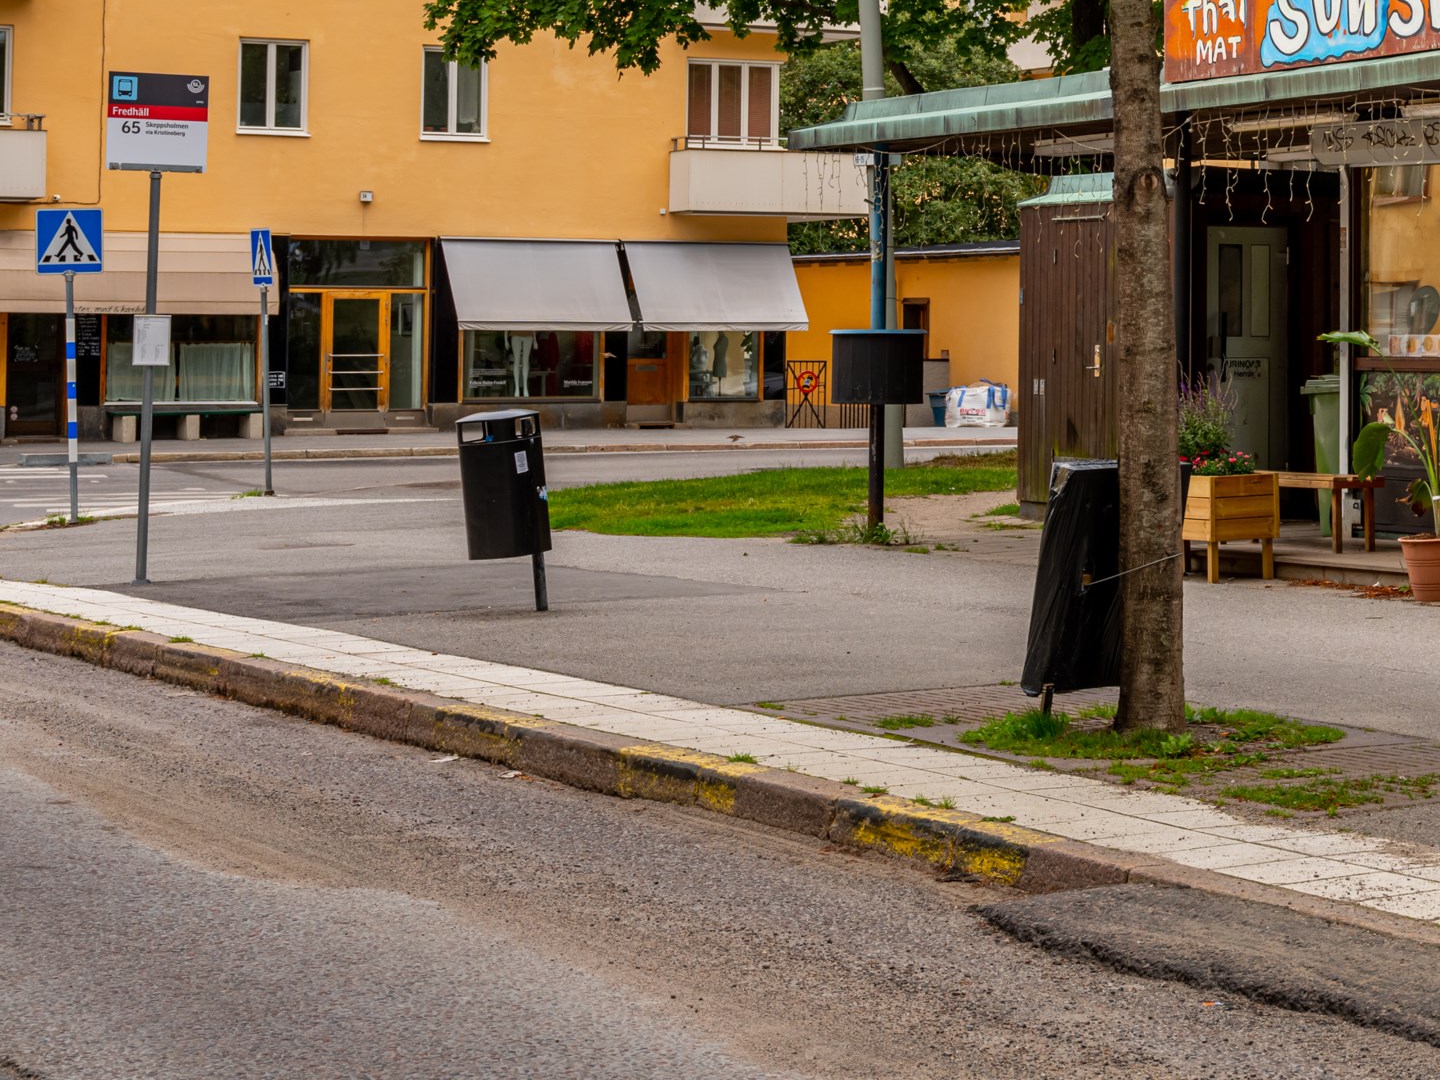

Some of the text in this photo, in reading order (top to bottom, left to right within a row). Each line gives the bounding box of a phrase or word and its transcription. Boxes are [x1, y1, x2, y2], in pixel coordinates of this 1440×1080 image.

[1195, 35, 1242, 65] MAT
[112, 106, 150, 117] Fredhäll
[121, 121, 189, 134] 65 Skeppsholmen
